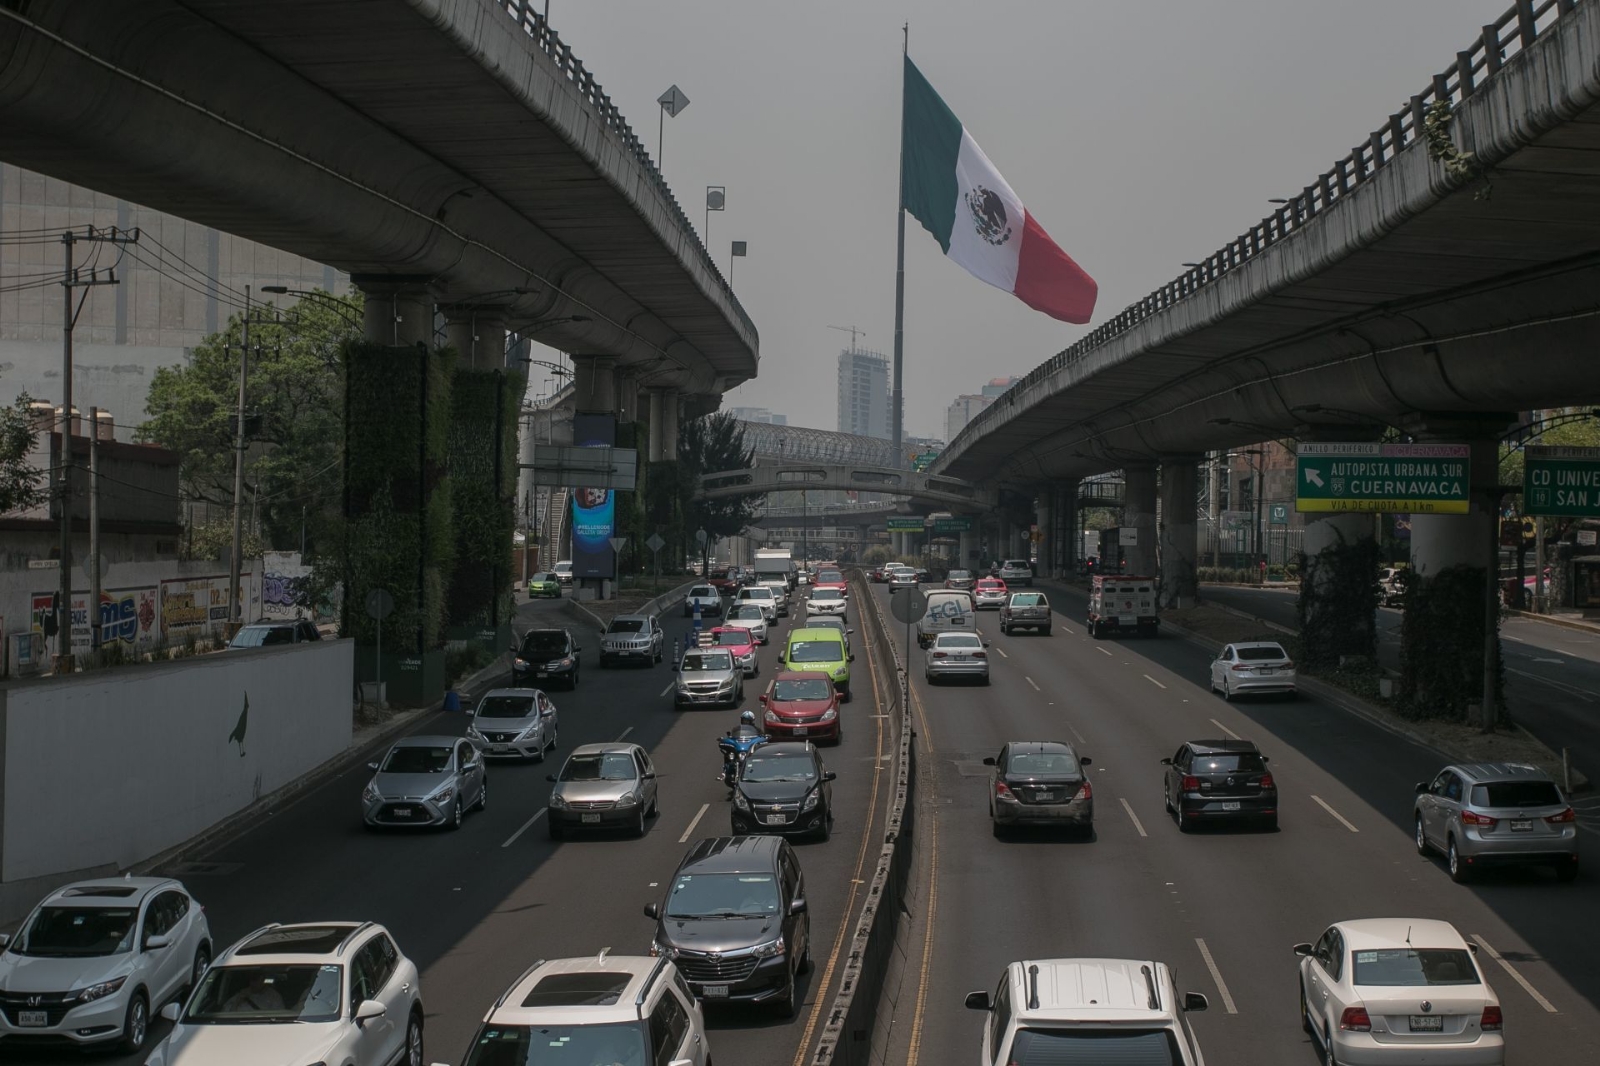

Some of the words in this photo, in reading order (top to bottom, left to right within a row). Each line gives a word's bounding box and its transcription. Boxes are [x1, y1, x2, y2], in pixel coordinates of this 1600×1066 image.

[1303, 445, 1329, 454] ANILLO
[1397, 447, 1467, 457] CUERNAVACA
[1331, 462, 1390, 477] AUTOPISTA
[1395, 463, 1438, 477] URBANA
[1442, 464, 1463, 478] SUR
[1532, 469, 1550, 486] CD
[1333, 483, 1343, 492] 95
[1350, 480, 1463, 496] CUERNAVACA
[1353, 501, 1363, 510] DE
[1367, 501, 1398, 510] CUOTA
[1403, 502, 1410, 510] A
[1536, 493, 1545, 503] 10
[1557, 490, 1587, 507] SAN
